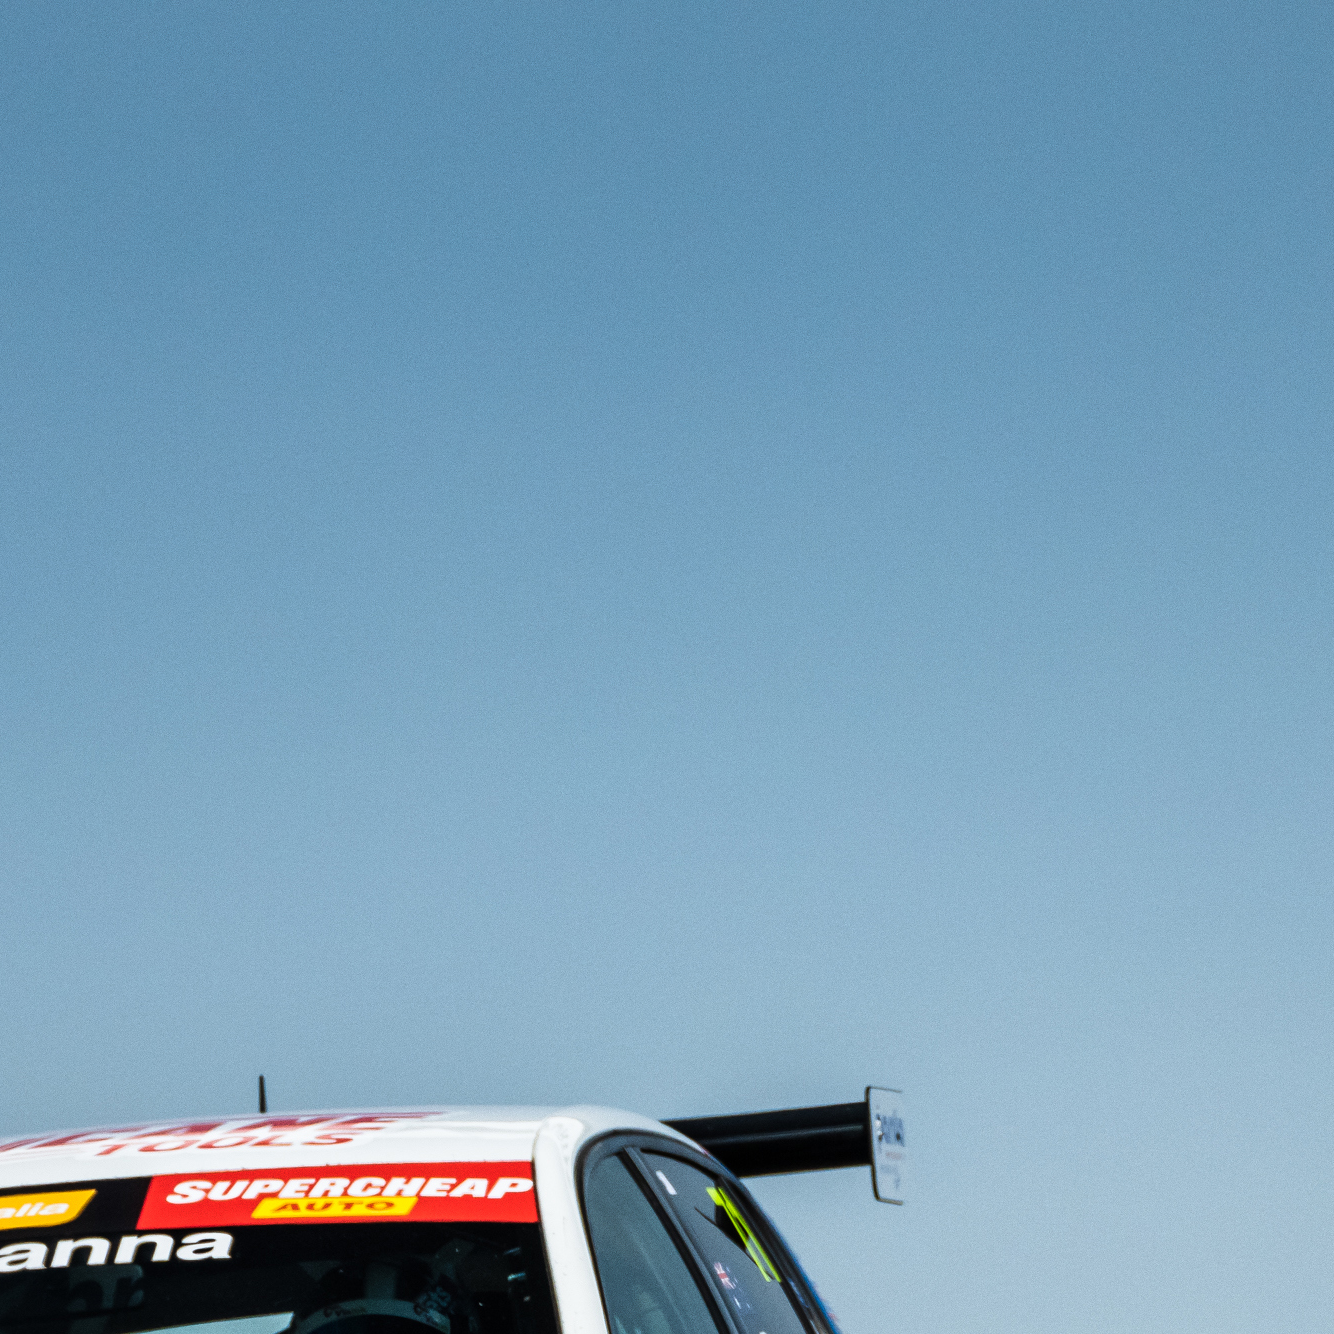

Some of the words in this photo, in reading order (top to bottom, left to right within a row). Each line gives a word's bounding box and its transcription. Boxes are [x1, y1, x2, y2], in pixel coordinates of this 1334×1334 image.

[94, 1131, 364, 1157] TOOLS
[165, 1176, 534, 1205] SUPERCHEAP
[270, 1199, 395, 1214] AUTO
